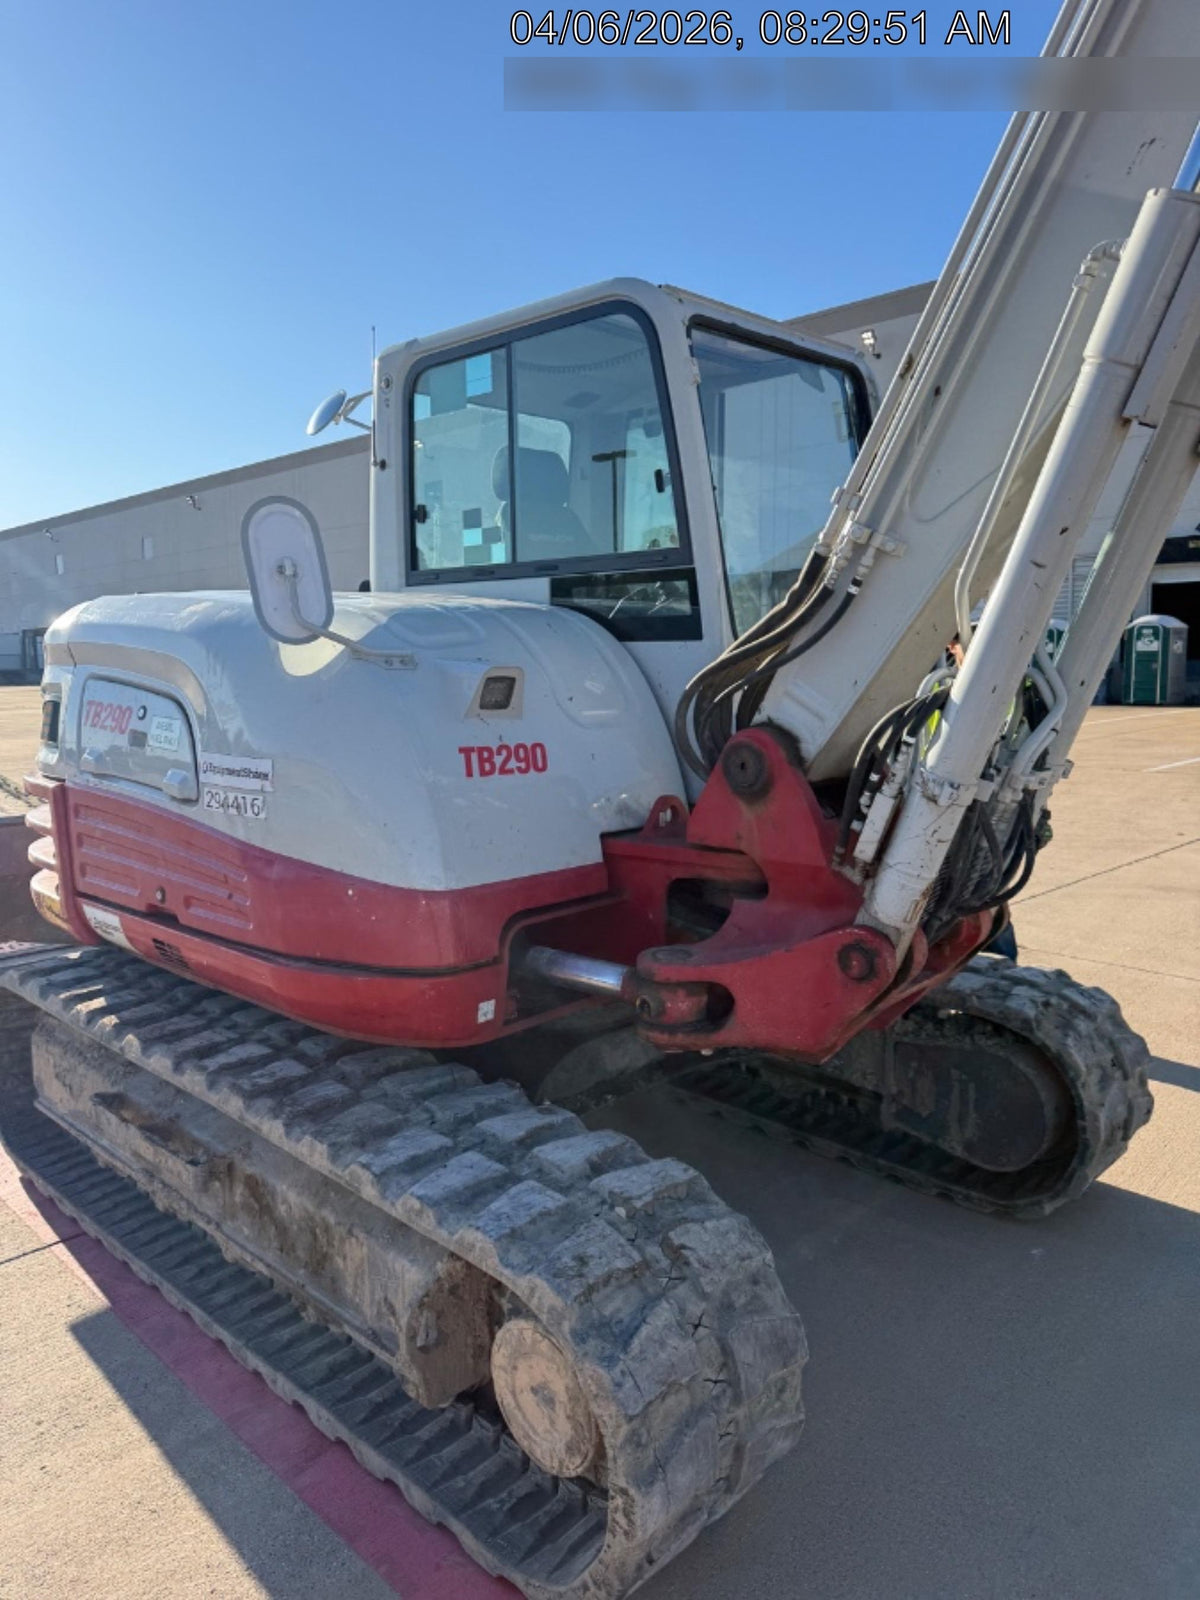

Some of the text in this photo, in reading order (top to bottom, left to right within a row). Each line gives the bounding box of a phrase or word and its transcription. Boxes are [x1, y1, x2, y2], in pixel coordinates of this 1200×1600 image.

[84, 700, 133, 735] TB290
[458, 742, 548, 778] TB290
[205, 790, 260, 817] 294416
